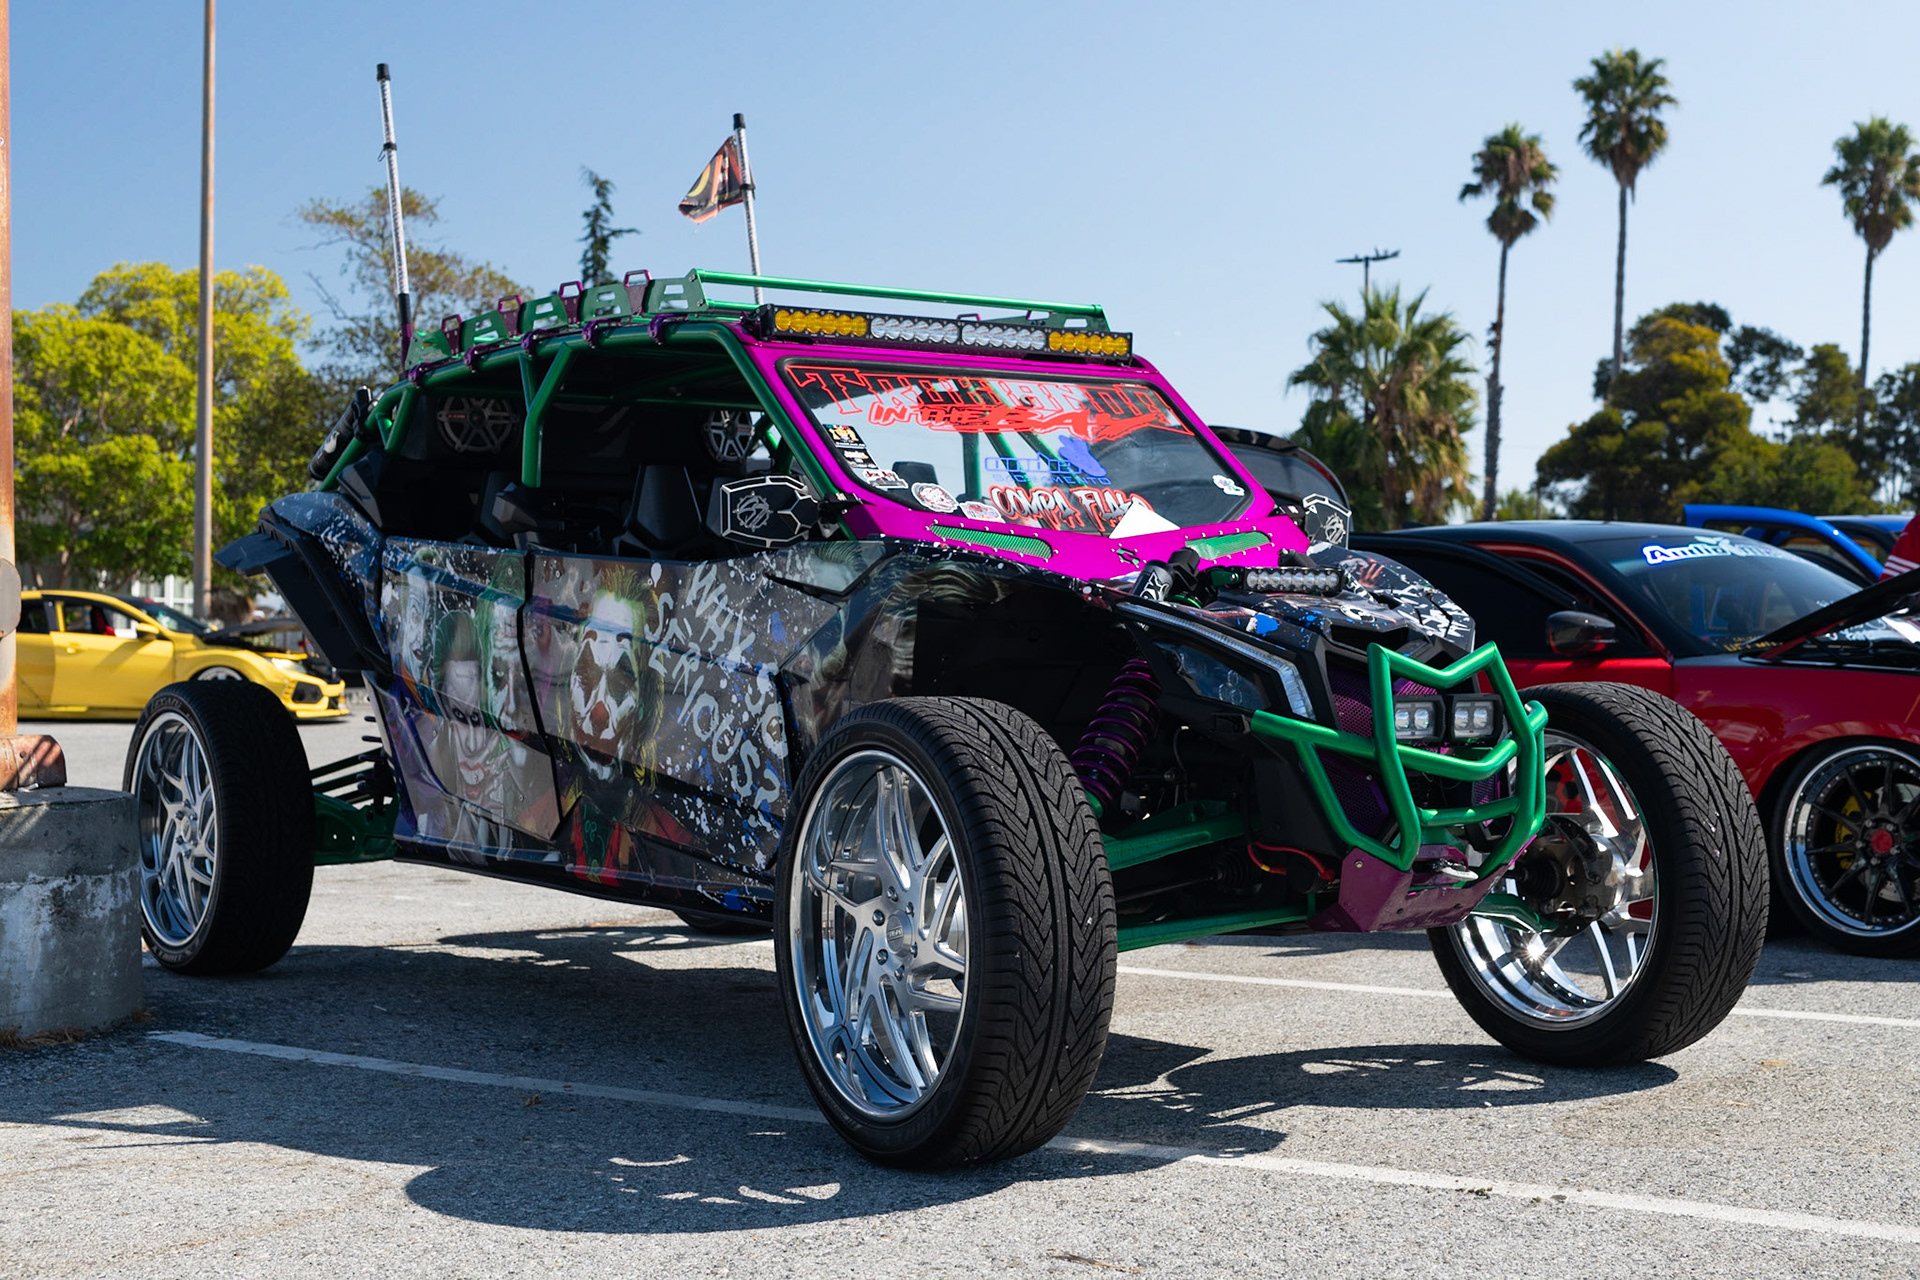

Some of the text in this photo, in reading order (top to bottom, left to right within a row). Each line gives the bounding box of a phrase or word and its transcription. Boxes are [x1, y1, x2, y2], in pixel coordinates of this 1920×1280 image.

[868, 402, 908, 426] IN
[989, 486, 1086, 530] COMPA
[992, 474, 1112, 486] SACRAMENTO
[685, 559, 756, 675] WHY
[644, 592, 781, 811] SERIOUS?
[744, 661, 790, 760] SO
